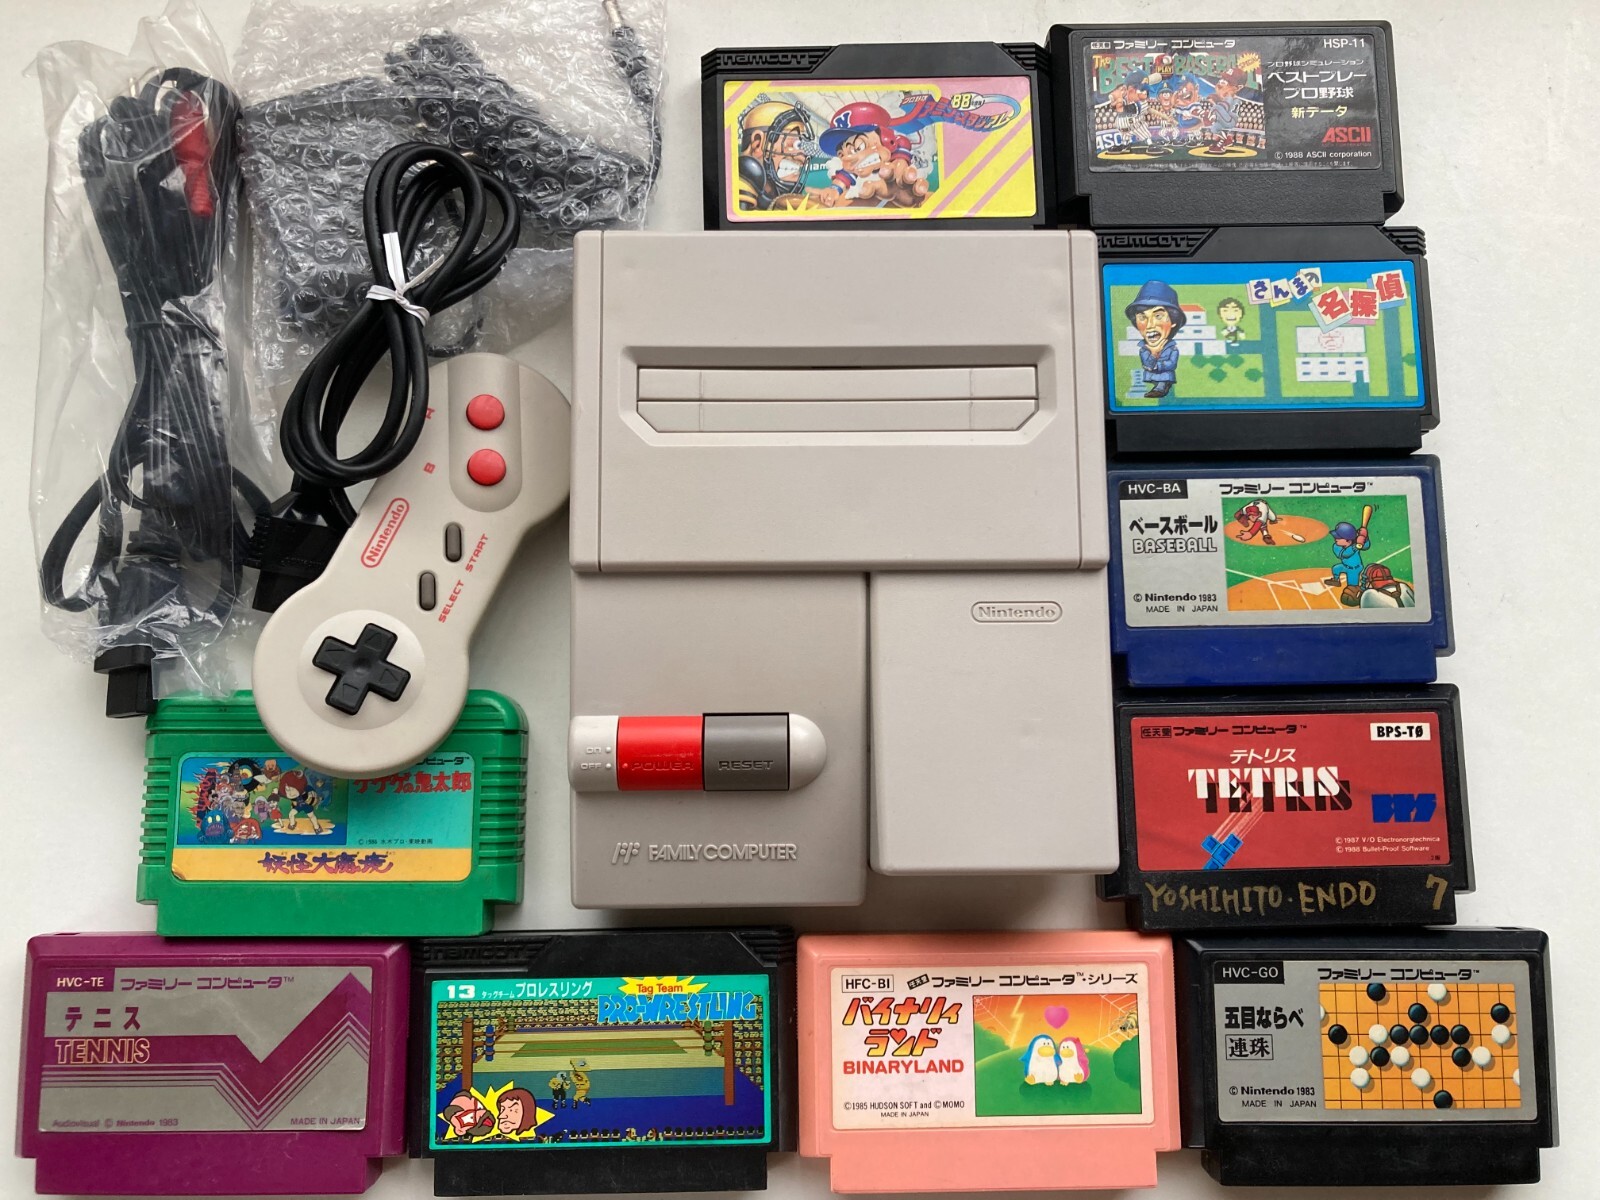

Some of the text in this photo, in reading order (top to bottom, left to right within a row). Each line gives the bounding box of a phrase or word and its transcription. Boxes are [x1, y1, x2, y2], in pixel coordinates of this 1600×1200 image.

[1113, 41, 1168, 50] ファミリー
[1171, 39, 1236, 49] コンピュータ
[1323, 38, 1365, 49] HSP-11
[1100, 56, 1152, 94] BEST
[1156, 65, 1173, 76] PLAY
[1267, 70, 1367, 83] ベストプレー
[1283, 86, 1354, 99] プロ野球
[1291, 105, 1348, 119] 新データ
[1322, 126, 1371, 143] ASCII
[1329, 150, 1372, 159] corporation
[1253, 271, 1320, 299] さんまの
[1317, 273, 1405, 320] 名探偵
[423, 462, 436, 474] B
[1128, 483, 1182, 495] HVC-BA
[1218, 483, 1285, 495] ファミリー
[1129, 515, 1218, 536] ベースボール
[366, 503, 405, 562] Nintendo
[465, 533, 489, 572] START
[1133, 538, 1218, 554] BASEBALL
[438, 579, 465, 623] SELECT
[1144, 593, 1197, 602] Nintendo
[1199, 593, 1217, 602] 1983
[978, 606, 1056, 618] Nintendo
[1145, 605, 1170, 613] MADE
[1173, 726, 1229, 736] ファミリー
[1230, 748, 1296, 764] テトリス
[580, 762, 602, 770] OFF
[631, 762, 695, 771] POWER
[718, 760, 774, 771] RESET
[1188, 766, 1345, 803] TETRIS
[648, 843, 797, 861] FAMILY COMPUTER
[1426, 874, 1449, 911] 7
[1222, 967, 1279, 978] HVC-GO
[1317, 968, 1387, 980] ファミリー
[56, 977, 105, 988] HVC-TE
[120, 978, 193, 991] ファミリー
[636, 983, 683, 994] Tag Team
[845, 978, 891, 990] HFC-BI
[931, 976, 995, 988] ファミリー
[447, 984, 476, 999] 13
[515, 981, 593, 998] プロレスリング
[597, 991, 758, 1023] PRO-WRESTLING
[64, 1006, 141, 1031] テニス
[1224, 1006, 1305, 1029] 五目ならべ
[864, 1027, 942, 1057] ランド
[1228, 1037, 1271, 1057] 連珠
[54, 1037, 151, 1064] TENNIS
[843, 1059, 964, 1074] BINARYLAND
[1240, 1086, 1295, 1095] Nintendo
[1296, 1087, 1315, 1096] 1983
[870, 1102, 898, 1110] HUDSON
[900, 1101, 918, 1109] SOFT
[920, 1101, 932, 1109] and
[116, 1119, 155, 1127] Nintendo
[159, 1118, 179, 1126] 1983
[290, 1117, 360, 1125] MADE IN JAPAN
